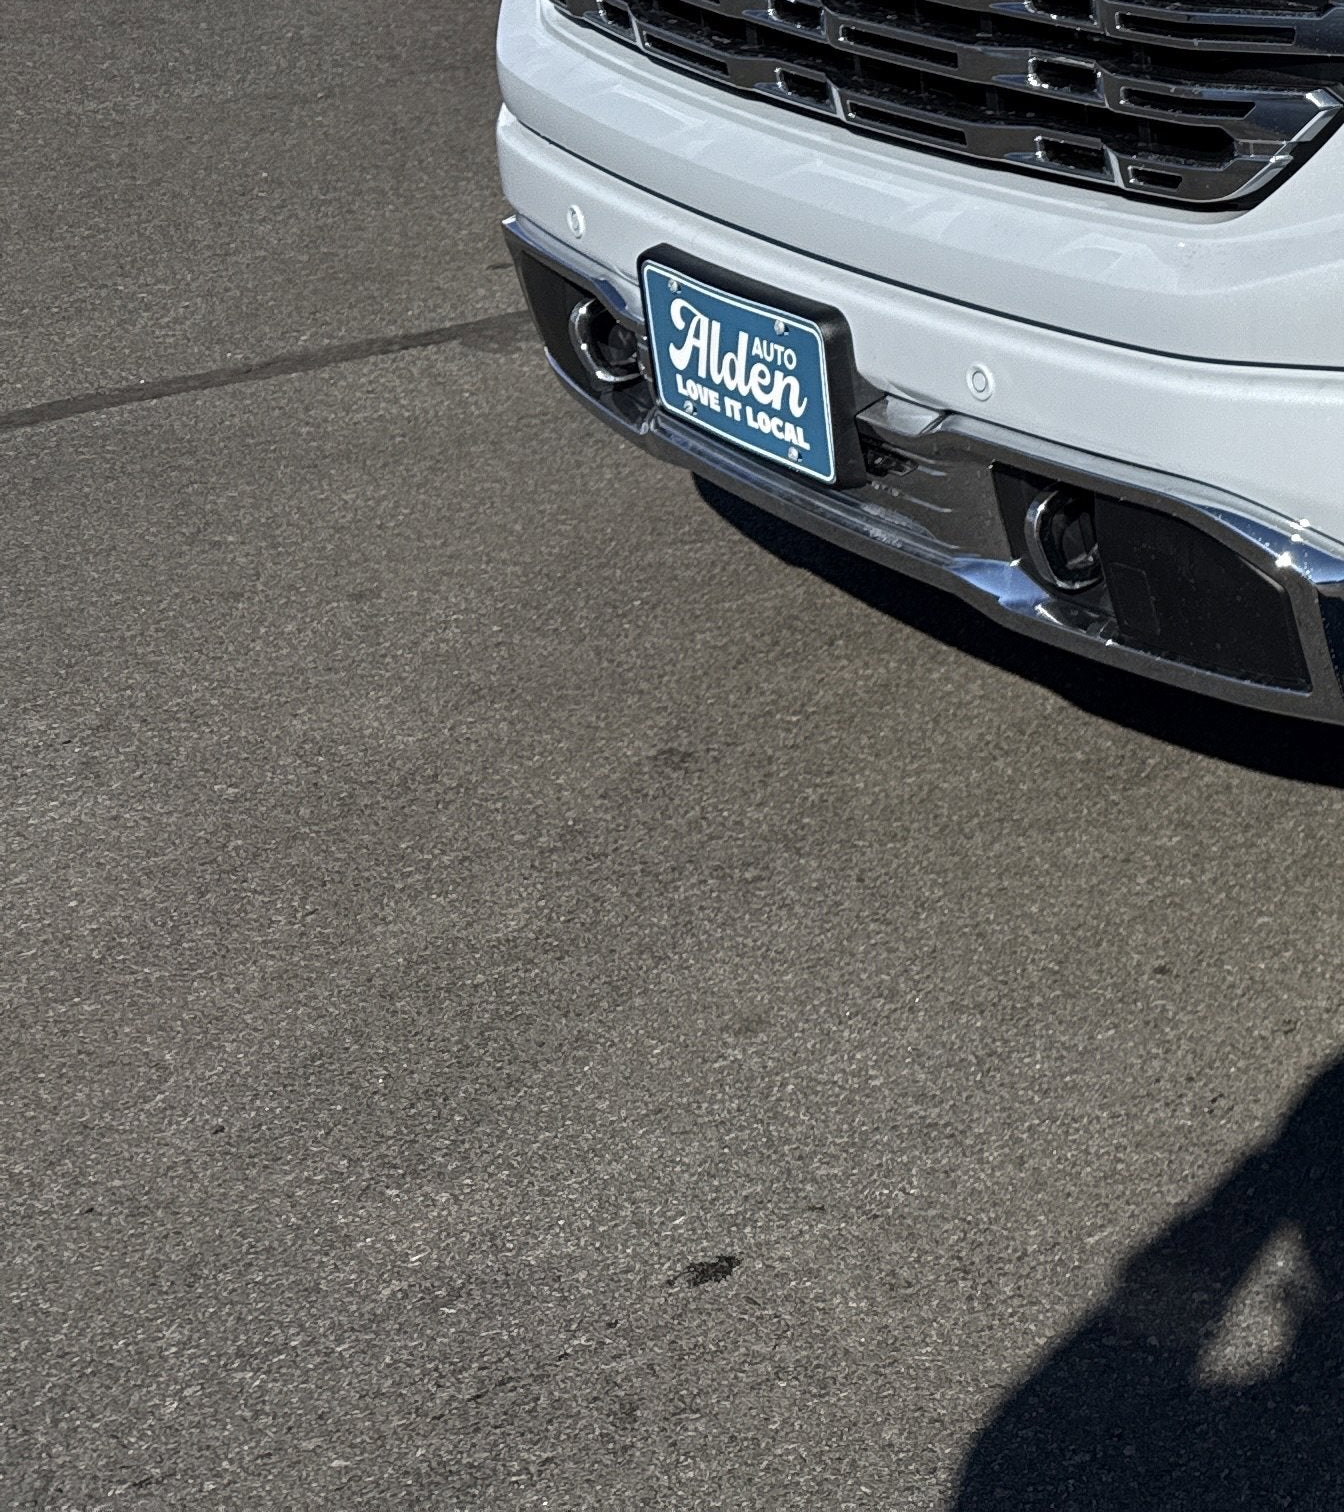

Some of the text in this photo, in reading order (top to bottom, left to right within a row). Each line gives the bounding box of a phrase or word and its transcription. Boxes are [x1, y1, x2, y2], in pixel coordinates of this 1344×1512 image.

[668, 297, 808, 418] Alden
[751, 336, 797, 371] AUTO
[675, 373, 811, 451] LOVE IT LOCAL
